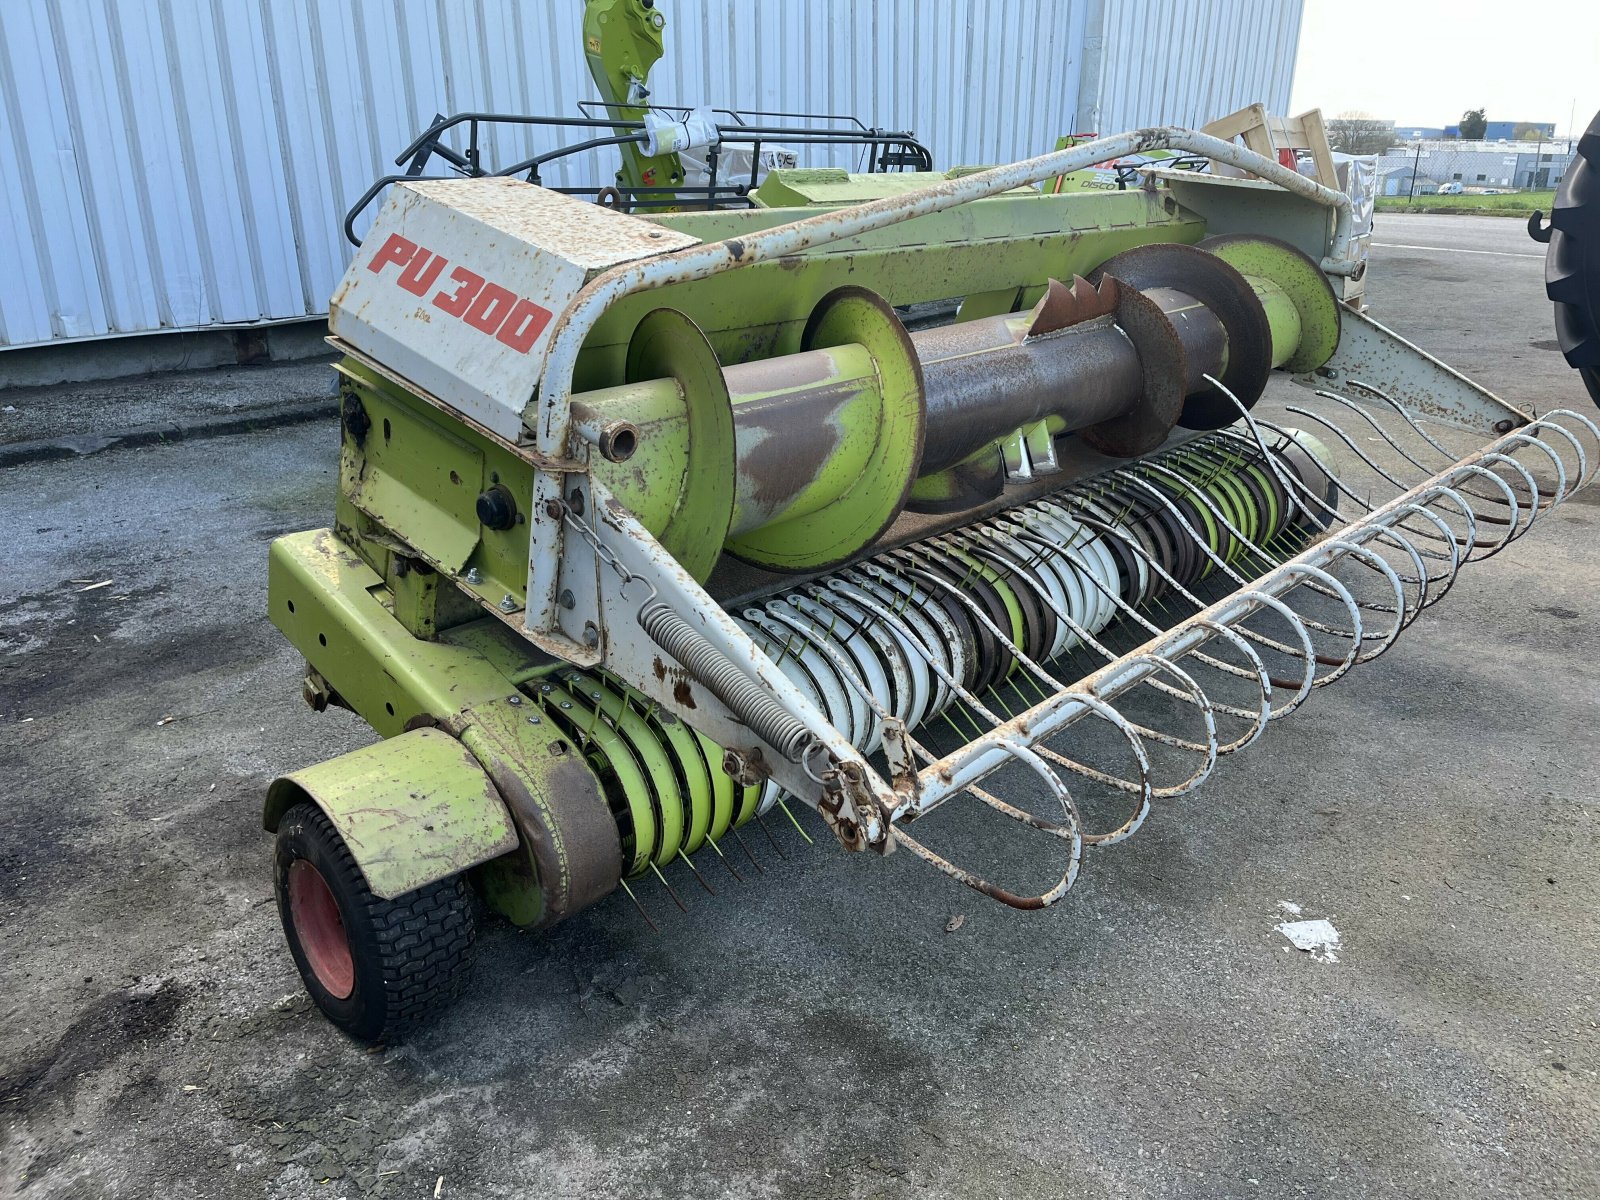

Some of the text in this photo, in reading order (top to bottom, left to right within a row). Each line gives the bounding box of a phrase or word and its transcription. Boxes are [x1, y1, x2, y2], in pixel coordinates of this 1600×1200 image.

[1081, 180, 1116, 191] DISCO
[367, 232, 553, 354] PU 300
